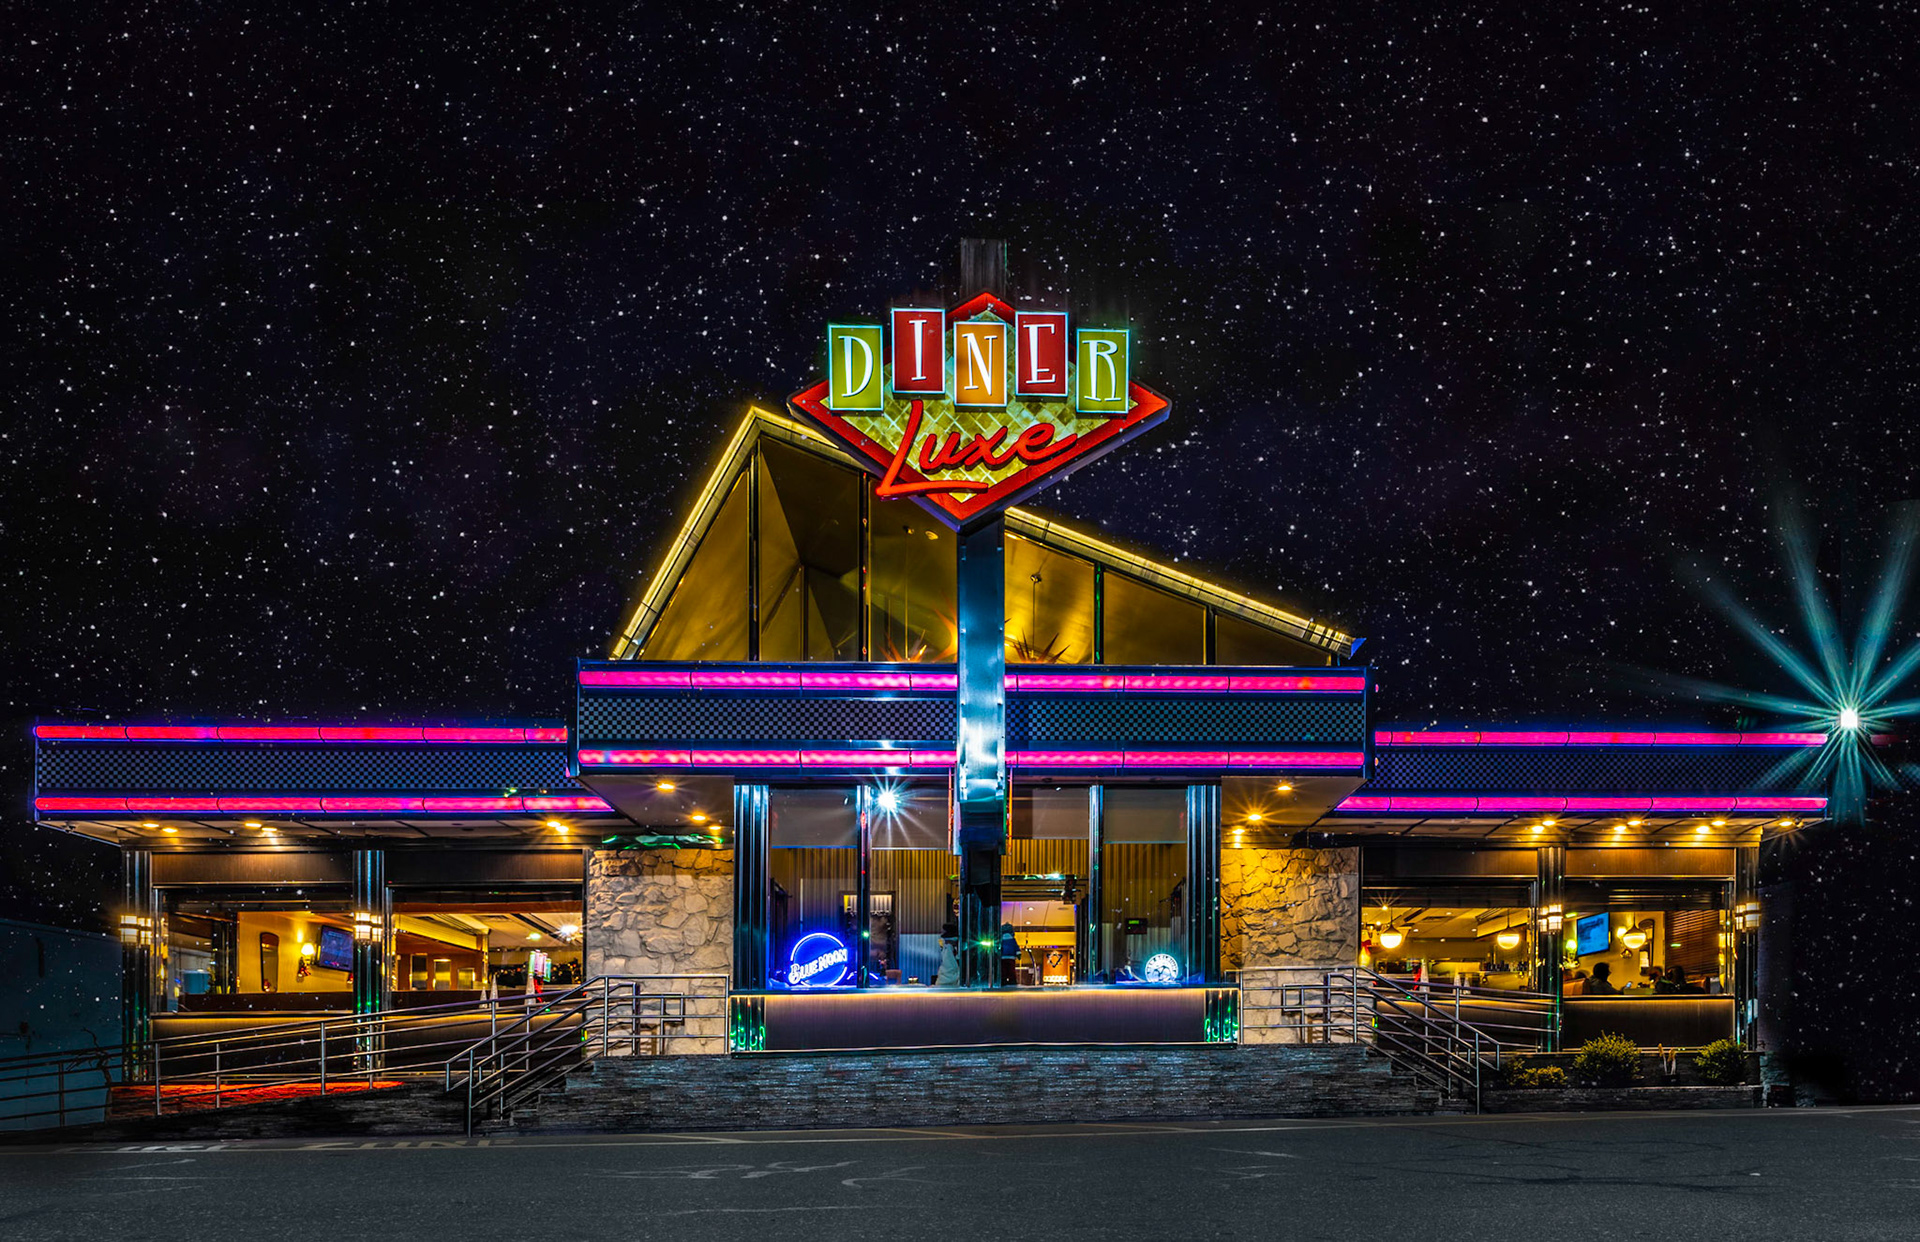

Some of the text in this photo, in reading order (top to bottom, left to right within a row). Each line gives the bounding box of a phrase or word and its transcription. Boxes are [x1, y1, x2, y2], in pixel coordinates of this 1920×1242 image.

[837, 318, 1121, 402] DINER
[875, 399, 1078, 500] Luxe
[788, 948, 848, 984] BLUE MOON
